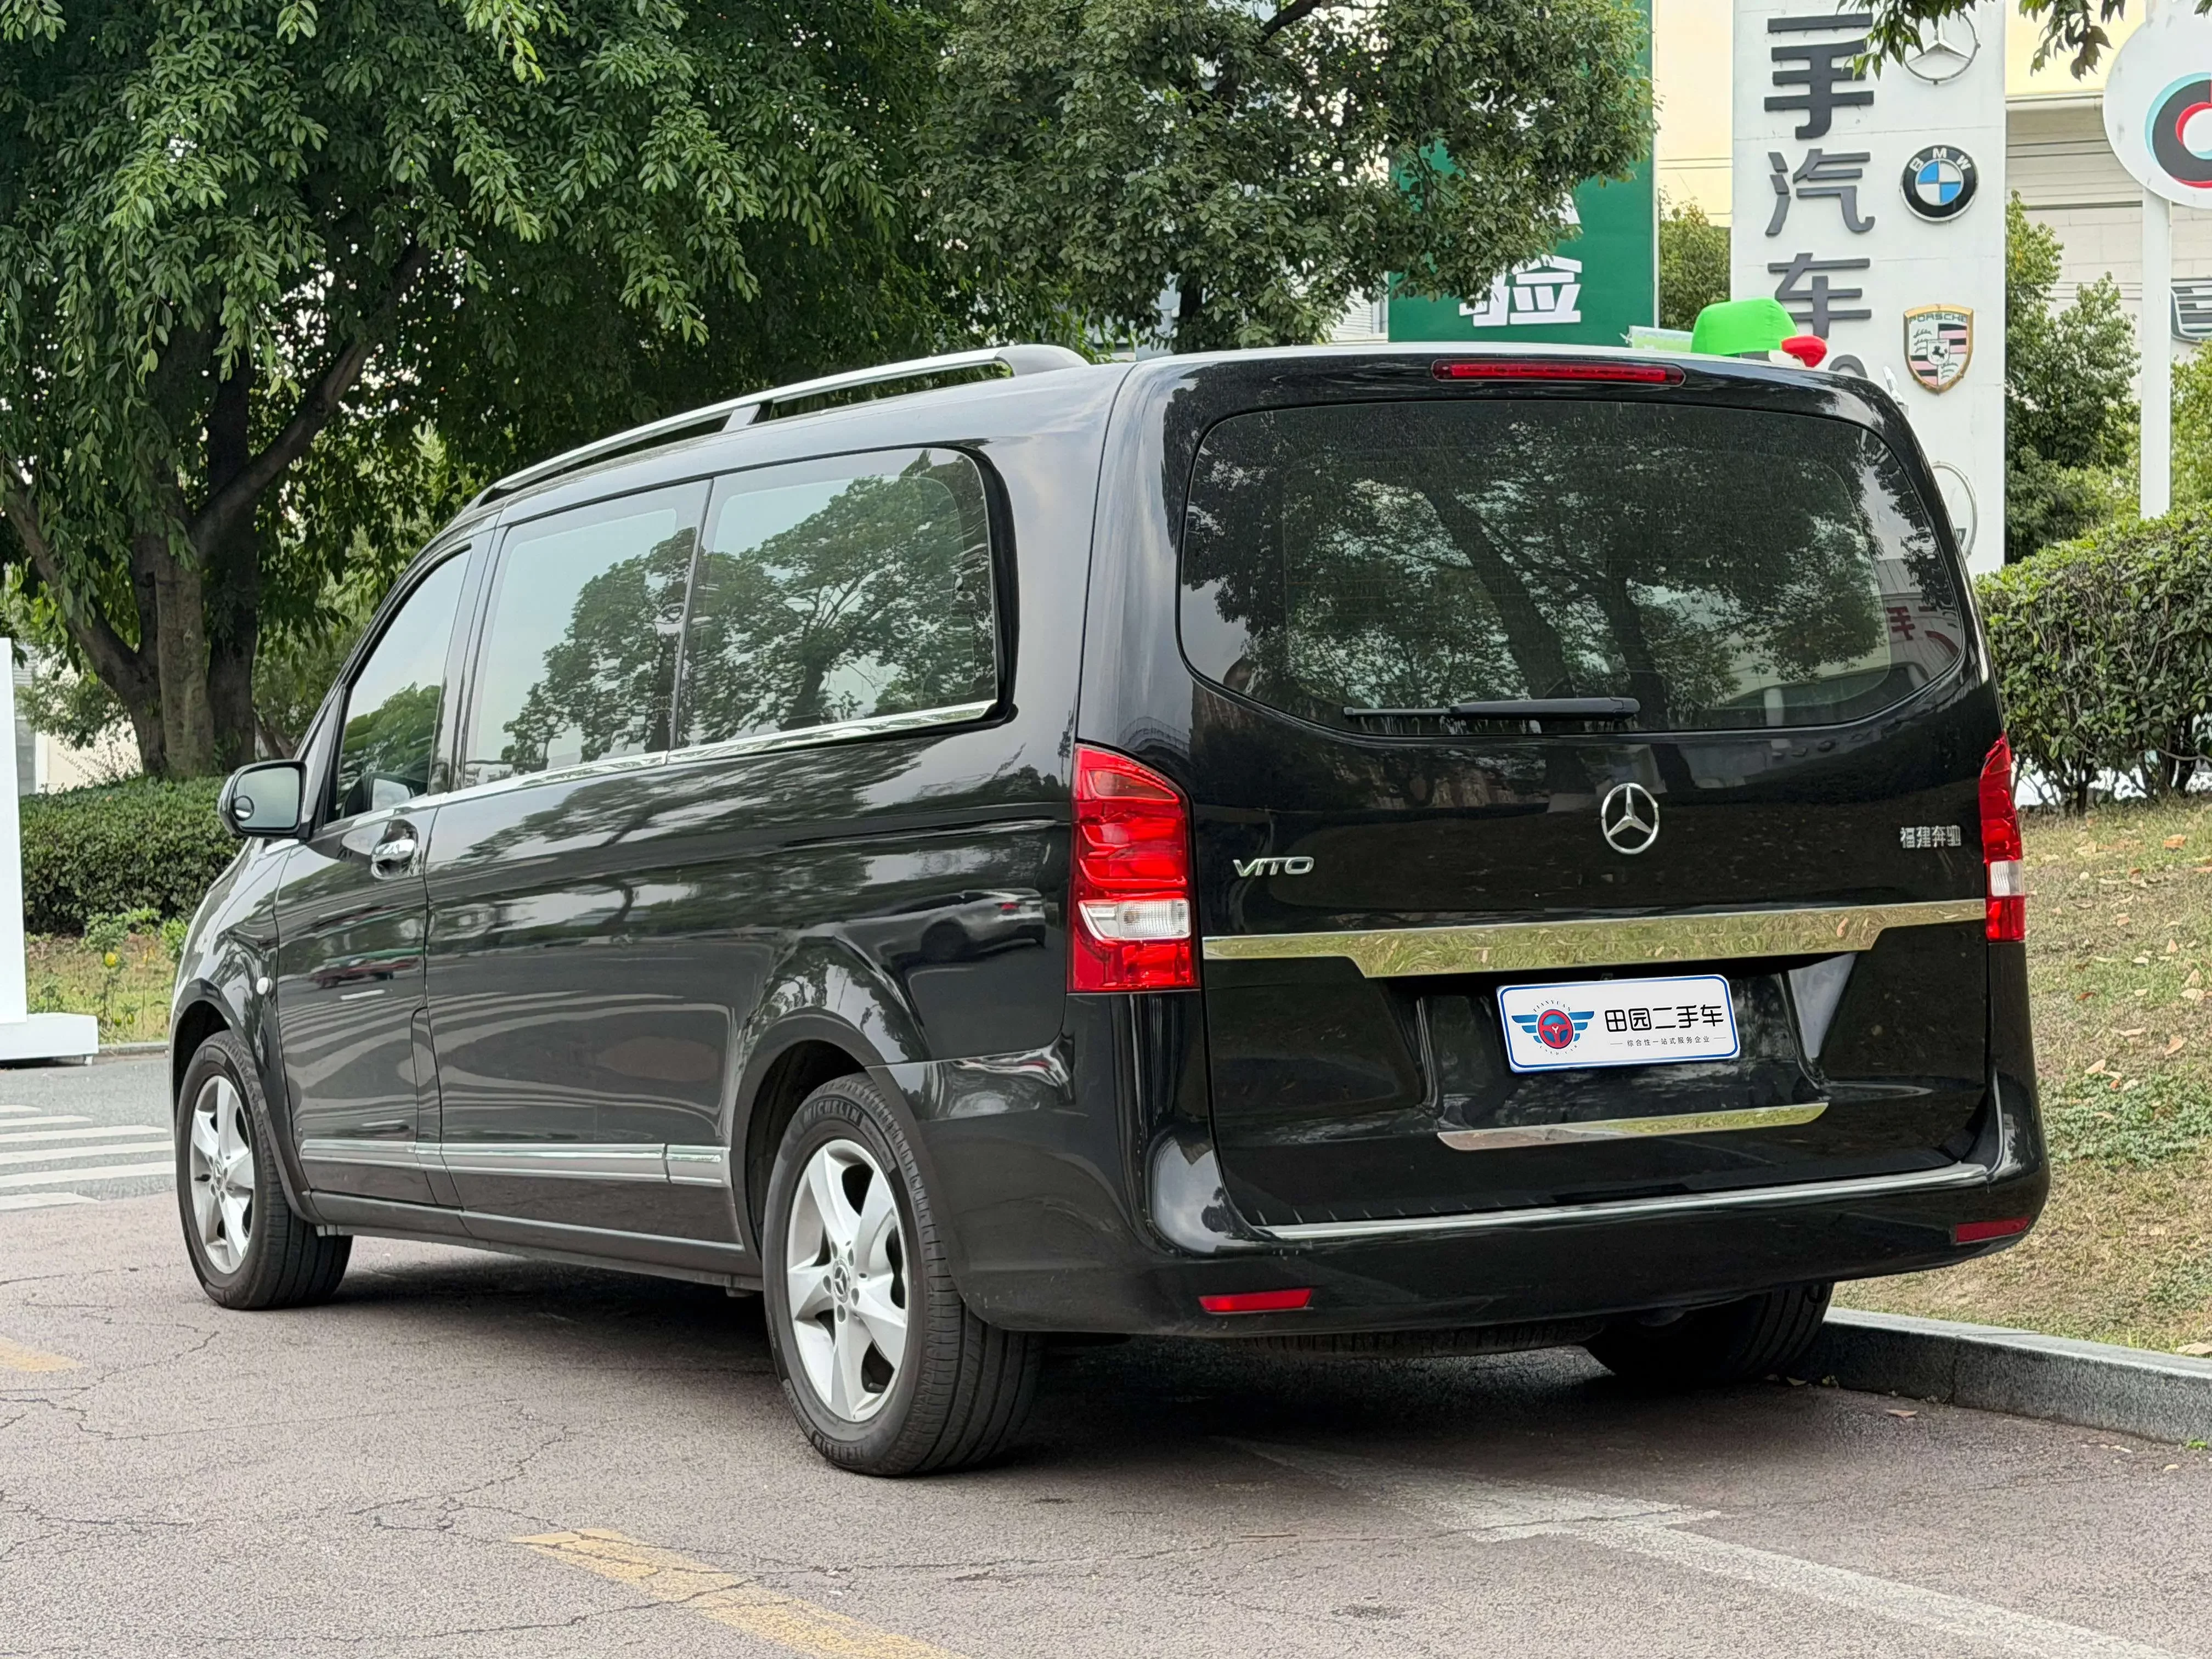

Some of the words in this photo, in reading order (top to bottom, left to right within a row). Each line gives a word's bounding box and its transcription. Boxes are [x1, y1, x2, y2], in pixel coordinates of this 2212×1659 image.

[1909, 148, 1972, 172] BMW
[1900, 825, 1962, 849] 福建奔驰
[1233, 856, 1314, 877] VITO
[1605, 1004, 1724, 1032] 田园二手车
[1627, 1036, 1709, 1047] 综合性一站式服务企业
[803, 1099, 862, 1125] MICHELIN
